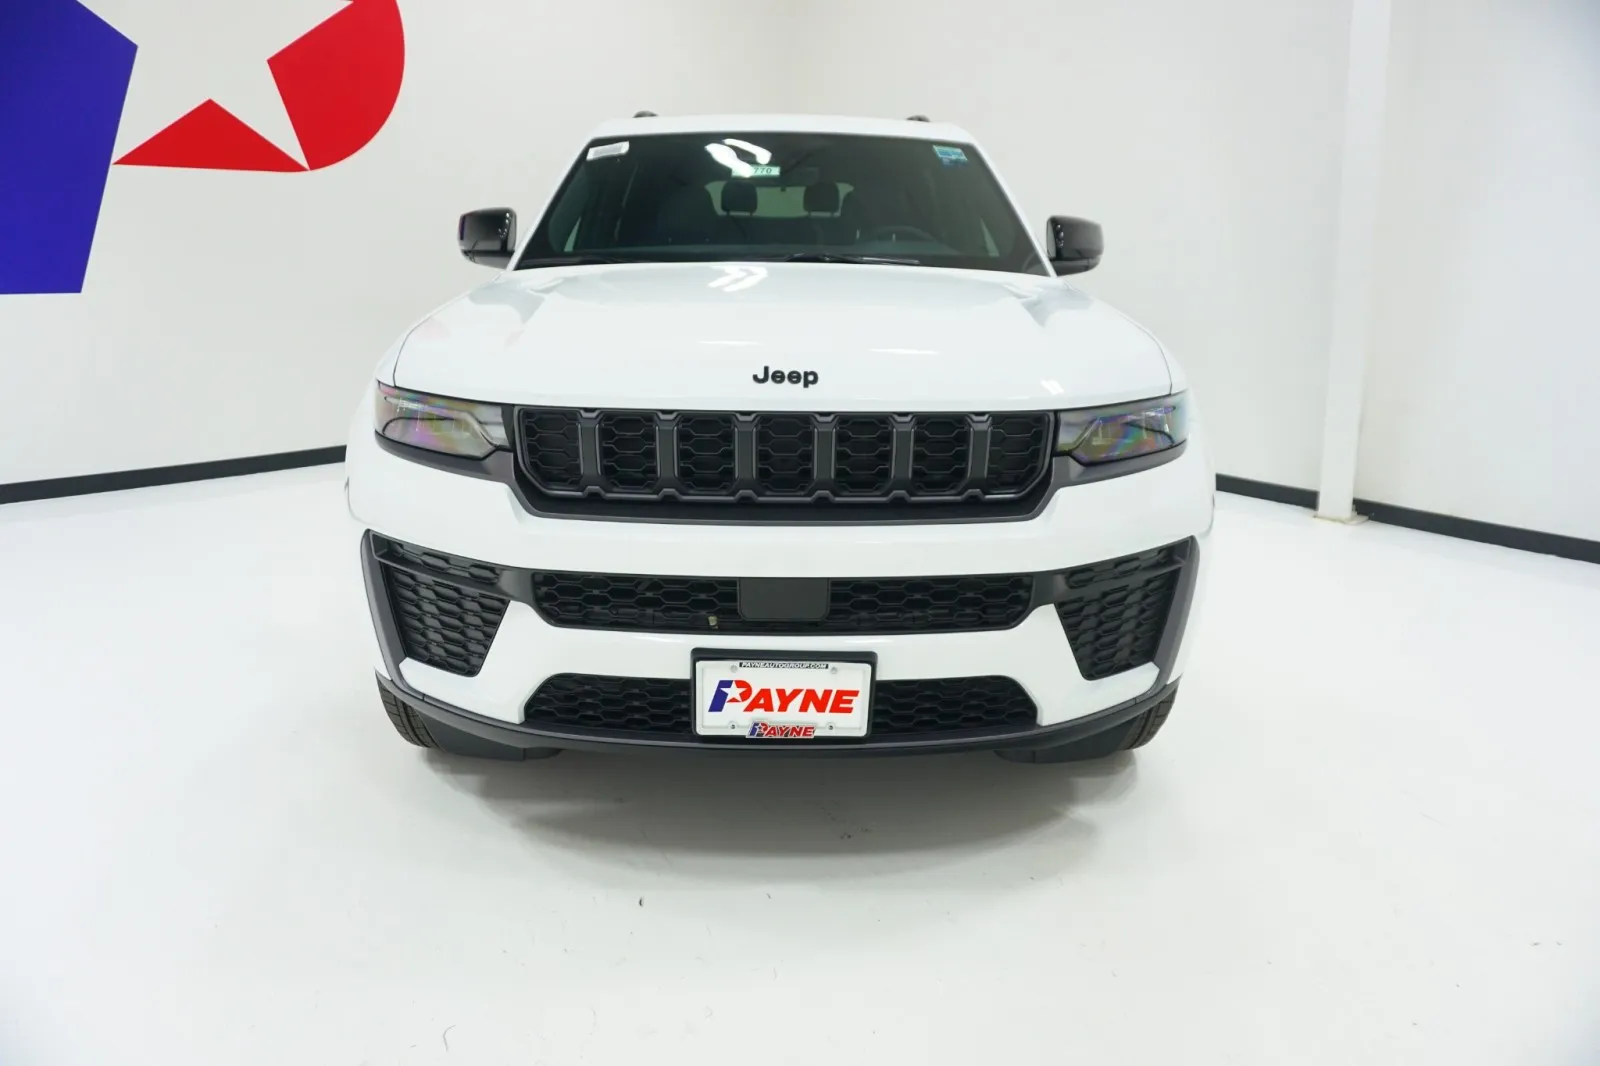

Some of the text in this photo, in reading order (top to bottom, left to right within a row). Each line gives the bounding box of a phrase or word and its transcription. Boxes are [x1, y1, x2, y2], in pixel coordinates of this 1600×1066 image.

[752, 365, 819, 388] Jeep
[708, 679, 859, 714] PAYNE
[748, 722, 815, 737] PAYNE
